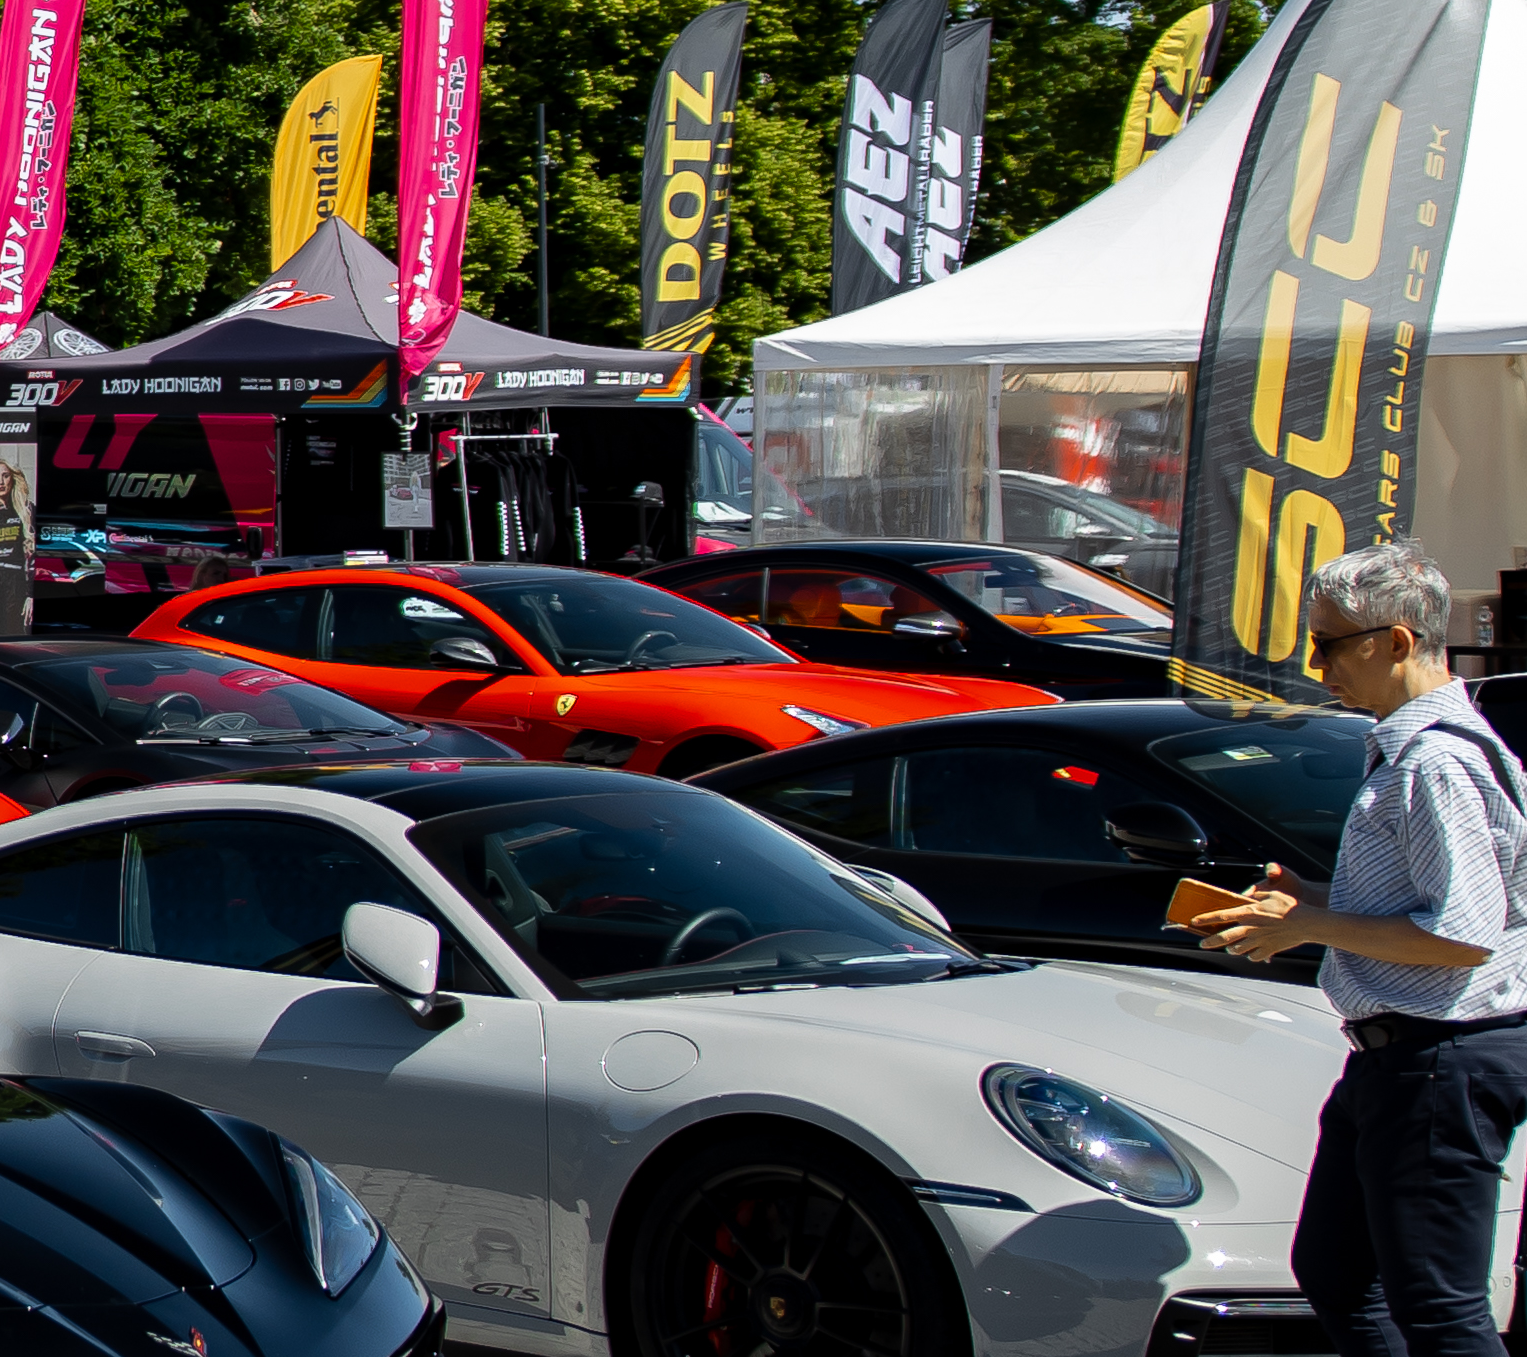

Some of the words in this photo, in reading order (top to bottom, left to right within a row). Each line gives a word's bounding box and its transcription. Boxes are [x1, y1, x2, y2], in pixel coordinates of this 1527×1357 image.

[655, 70, 715, 302] DOTZ
[707, 110, 735, 261] WHEELS
[842, 73, 913, 284] AEZ
[1383, 320, 1415, 433] CLUB
[1405, 244, 1430, 303] CZ
[1425, 124, 1450, 181] SK
[6, 379, 83, 407] 300V
[102, 379, 141, 395] LADY
[144, 377, 222, 394] HOONIGAN
[422, 372, 486, 402] 300V
[495, 371, 527, 389] LADY
[528, 369, 586, 387] HOONIGAN
[472, 1282, 540, 1302] GTS
